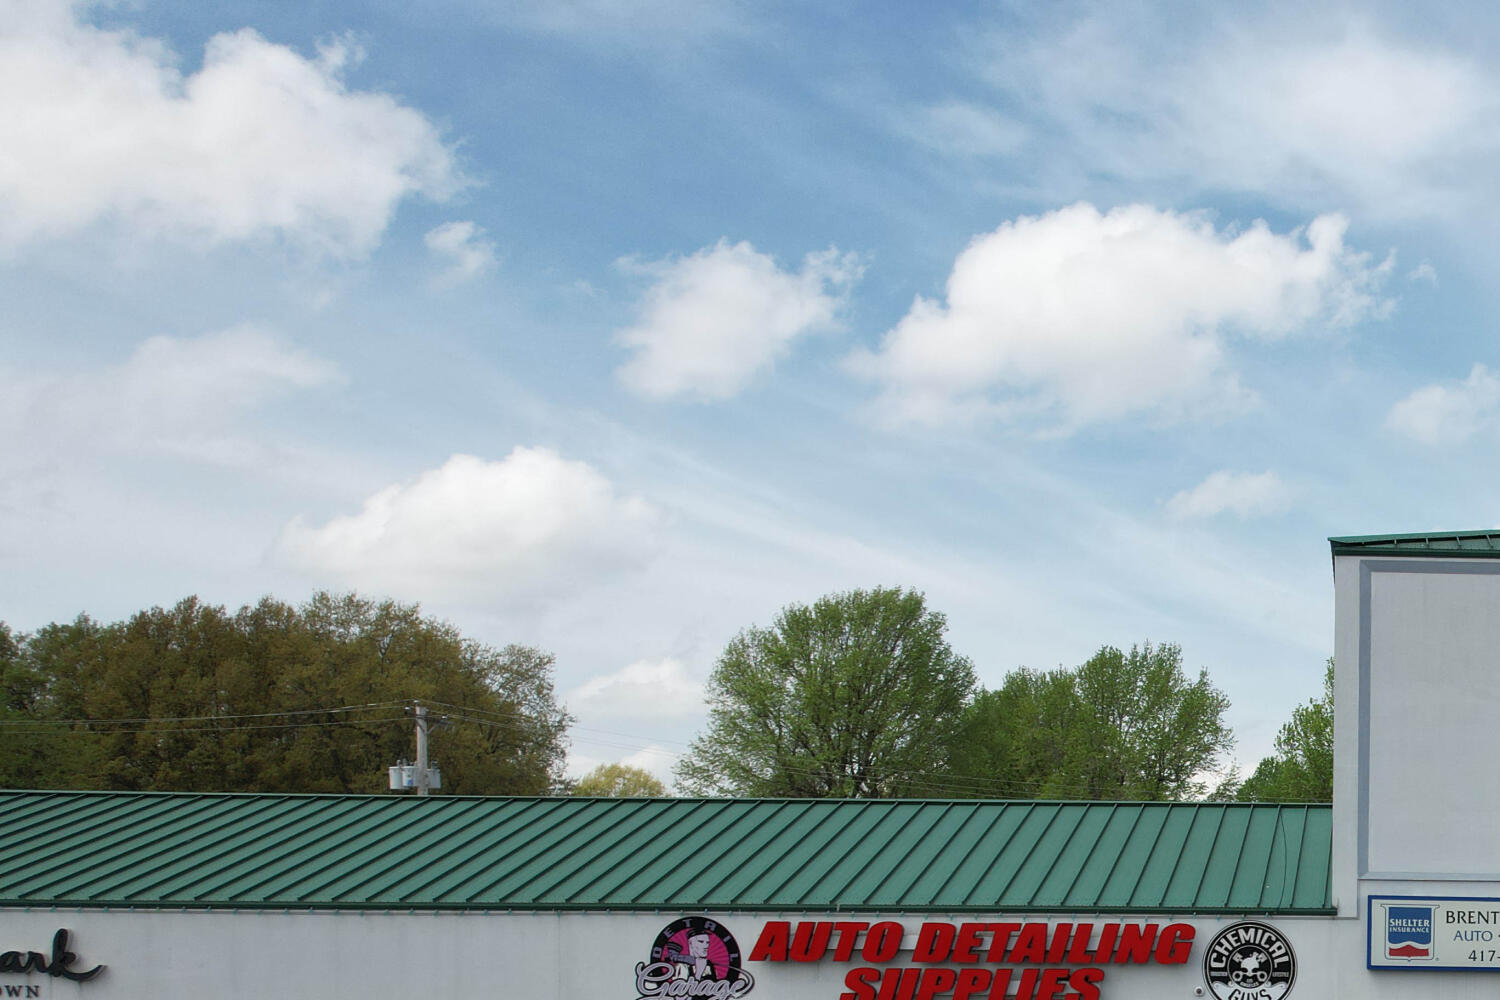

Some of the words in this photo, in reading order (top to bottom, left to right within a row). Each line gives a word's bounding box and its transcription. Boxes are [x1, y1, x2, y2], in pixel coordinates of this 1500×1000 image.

[1389, 918, 1430, 927] SHELTER
[1445, 911, 1500, 925] BRENT
[652, 919, 739, 959] DETAIL
[748, 921, 904, 963] AUTO
[912, 922, 1197, 965] DETAILING
[1453, 930, 1493, 942] AUTO
[1210, 927, 1290, 969] CHEMICAL
[0, 984, 40, 998] WN
